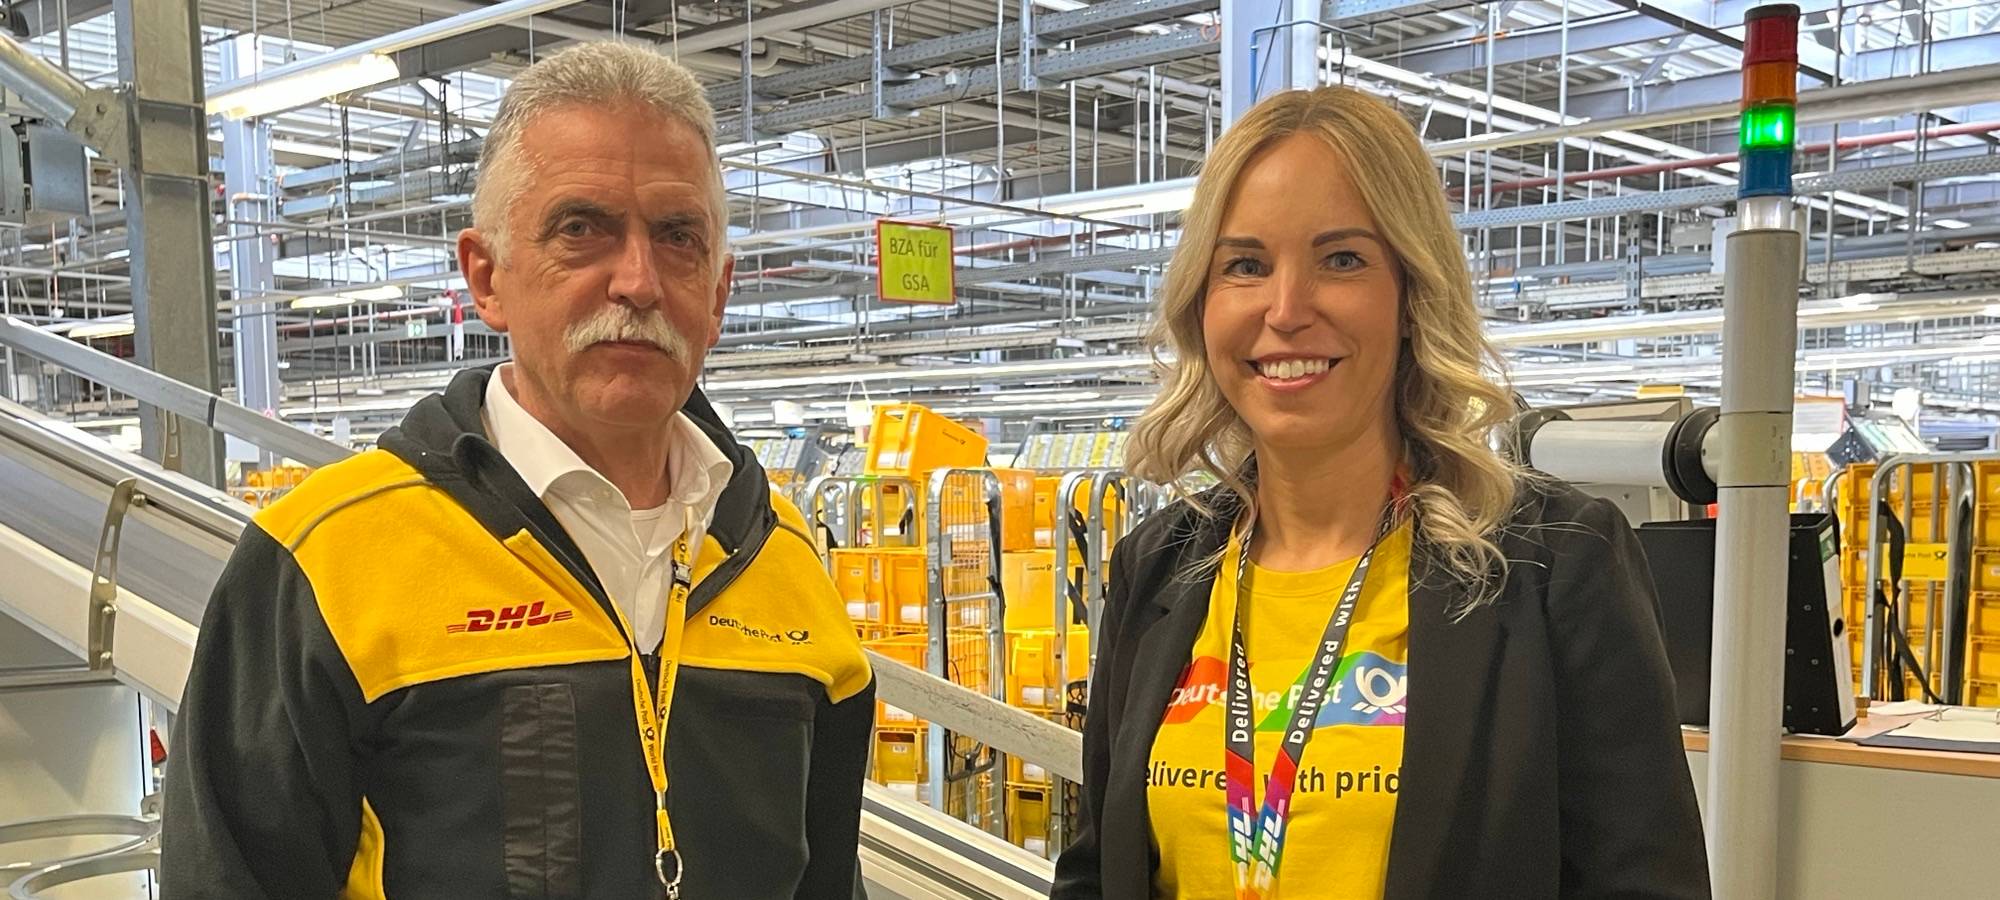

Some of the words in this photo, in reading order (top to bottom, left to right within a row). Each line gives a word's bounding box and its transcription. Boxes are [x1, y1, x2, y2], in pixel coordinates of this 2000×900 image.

[889, 237, 915, 256] BZA
[918, 240, 939, 258] für
[902, 273, 930, 292] GSA
[466, 600, 552, 632] DHL
[709, 615, 760, 638] Deutche
[759, 629, 783, 643] Pst
[1289, 639, 1340, 745] Delivered
[1334, 579, 1362, 628] with
[635, 678, 646, 709] Deutsche
[1167, 682, 1281, 711] Deutshe
[1287, 679, 1344, 710] Pst
[1230, 642, 1247, 744] Delivered
[640, 709, 650, 726] Post
[1144, 760, 1227, 791] livere
[1263, 767, 1325, 793] th
[1335, 765, 1401, 799] prid
[1253, 808, 1284, 891] DHL
